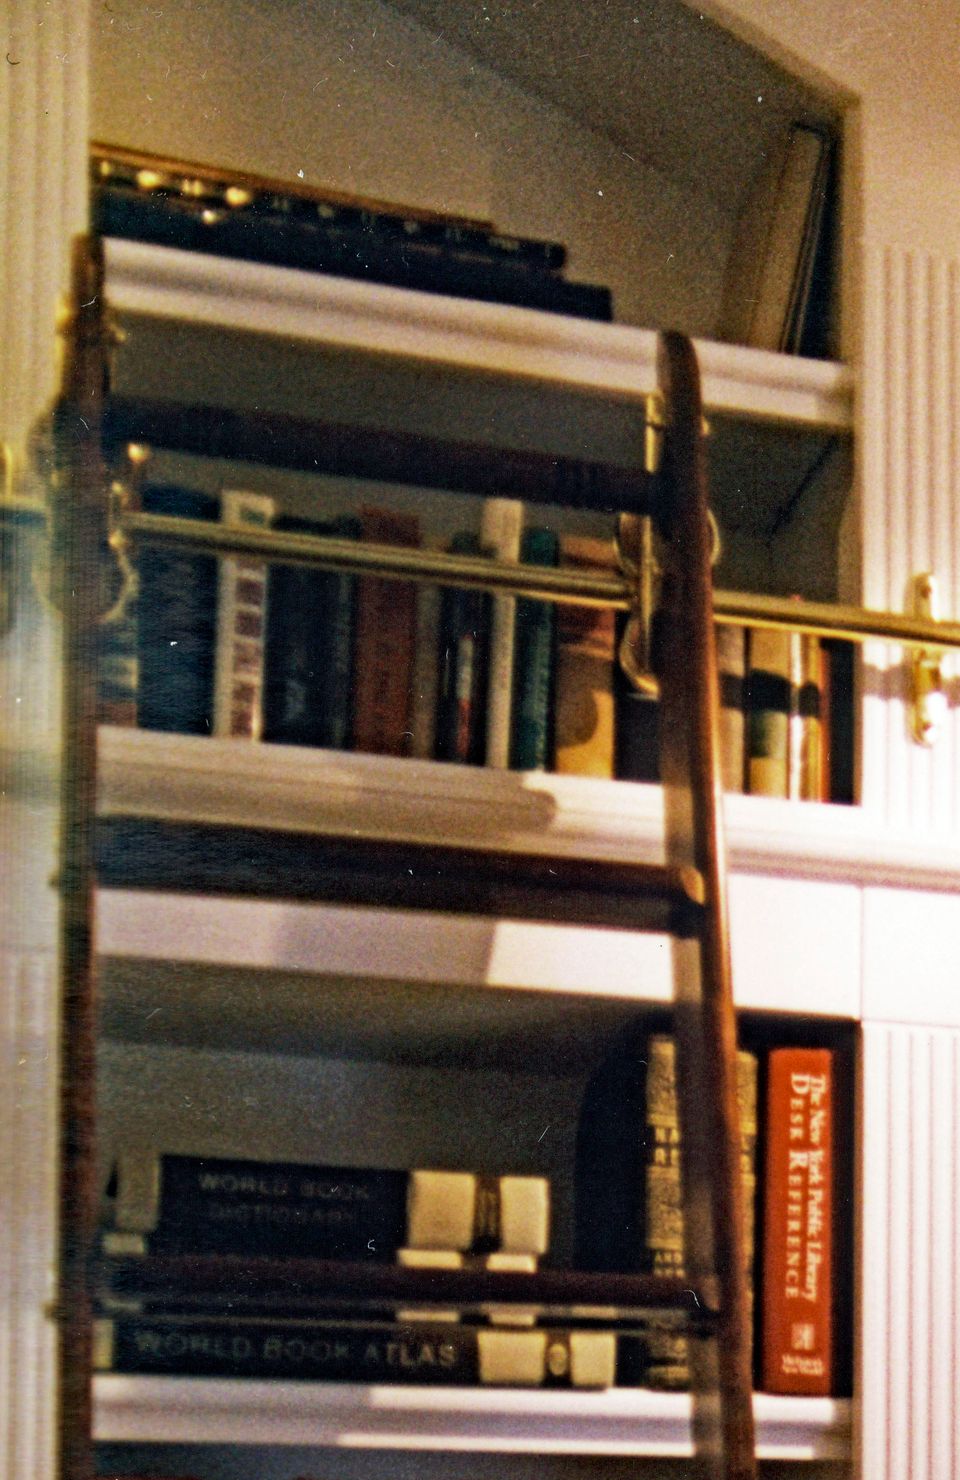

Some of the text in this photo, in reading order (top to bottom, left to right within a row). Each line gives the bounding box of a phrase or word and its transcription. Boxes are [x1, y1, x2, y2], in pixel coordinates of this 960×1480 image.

[785, 1072, 811, 1299] DESK REFERENCE
[800, 1074, 828, 1303] The New York Public Library
[133, 1330, 459, 1368] WORLD BOOK ATLAS
